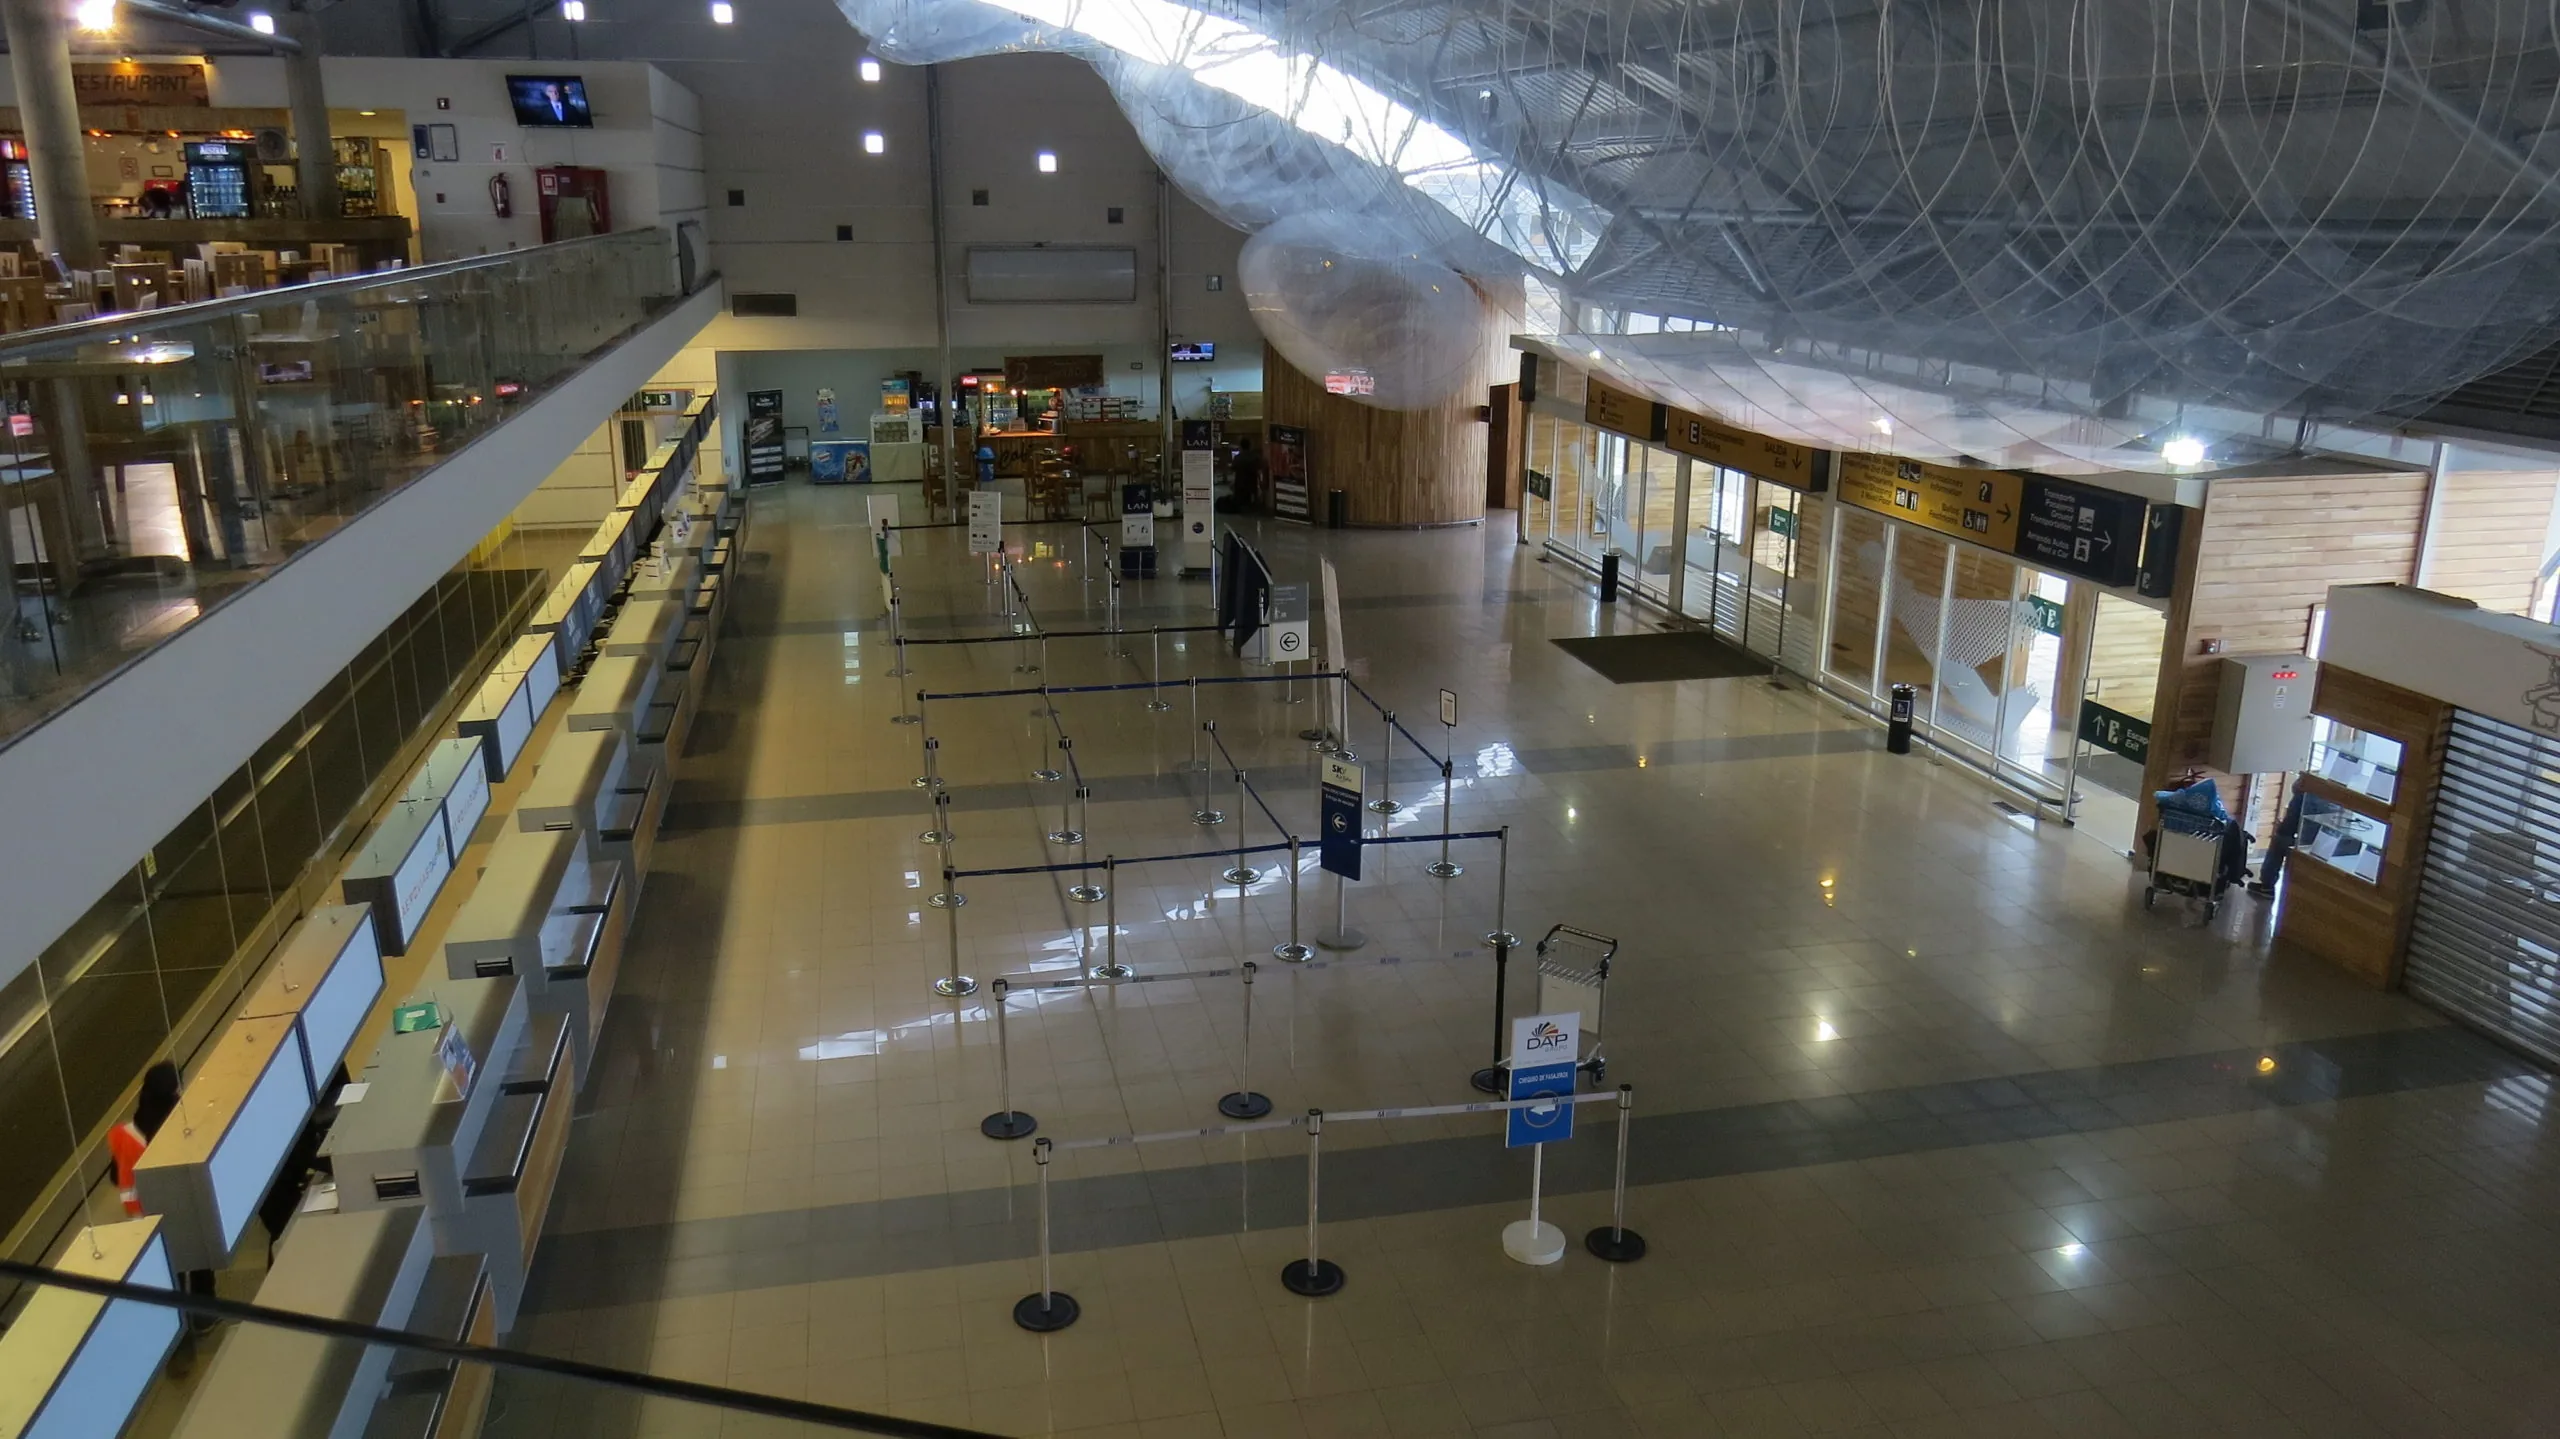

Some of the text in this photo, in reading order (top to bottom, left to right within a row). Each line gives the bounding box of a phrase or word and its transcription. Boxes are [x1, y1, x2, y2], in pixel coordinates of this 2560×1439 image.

[75, 74, 188, 91] ESTAURANT
[1187, 439, 1208, 447] LAN
[2051, 510, 2074, 522] Ground
[2127, 728, 2149, 745] Escap
[2125, 738, 2140, 752] Exit
[1527, 1034, 1568, 1050] DAP
